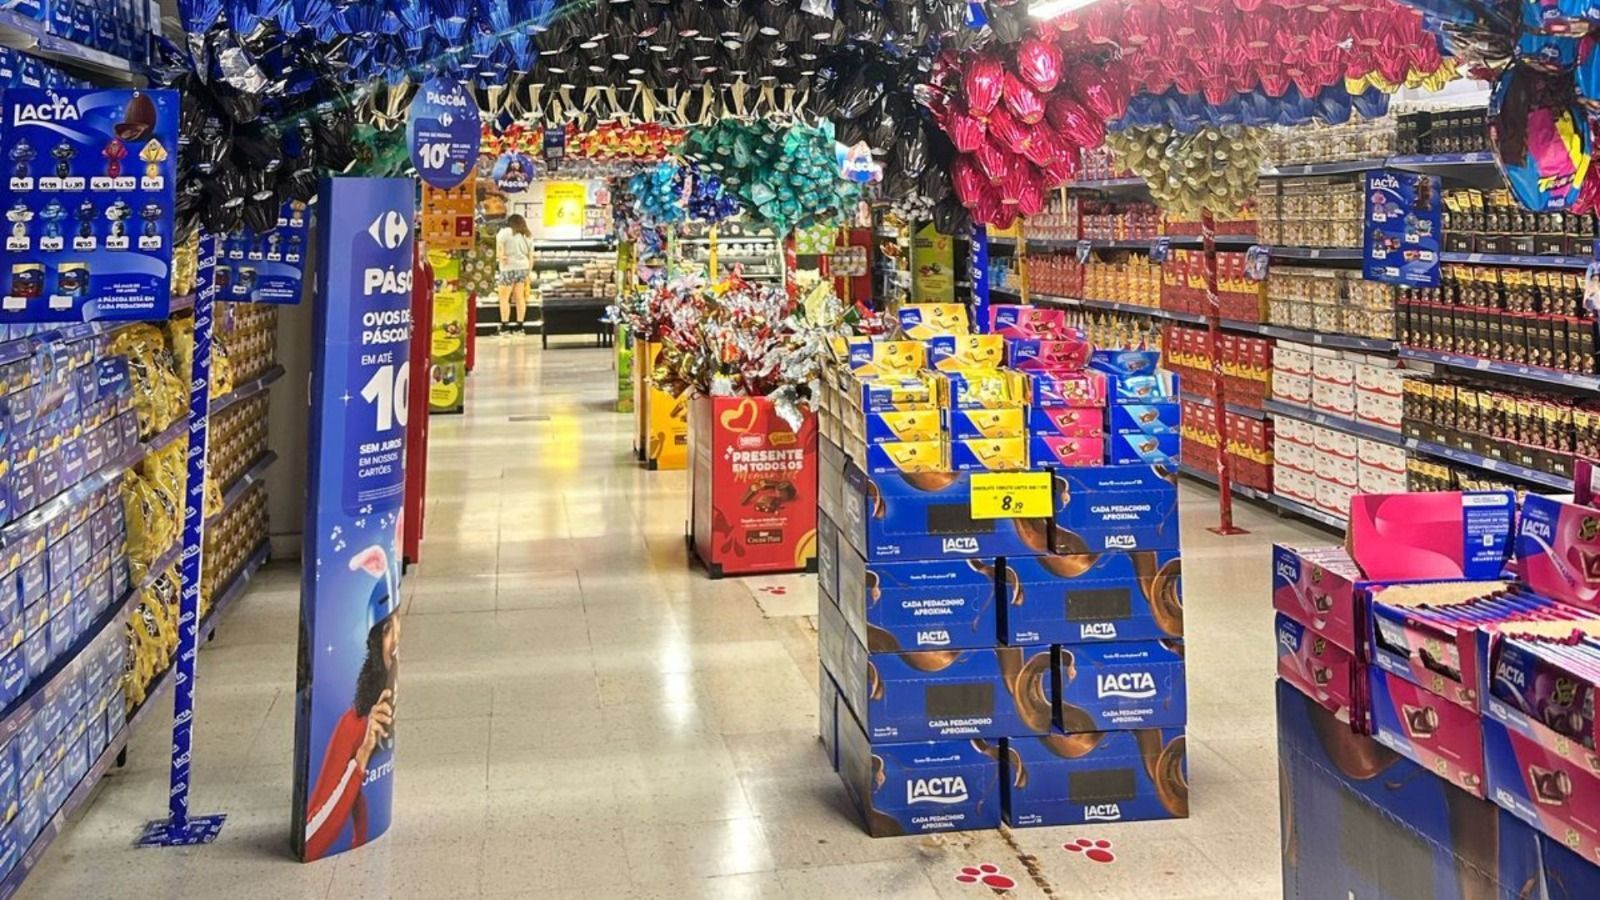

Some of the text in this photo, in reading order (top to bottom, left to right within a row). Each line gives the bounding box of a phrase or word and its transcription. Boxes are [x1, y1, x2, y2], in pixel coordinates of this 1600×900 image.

[14, 98, 79, 126] LACTA
[419, 143, 450, 169] 10X
[1371, 178, 1400, 190] LACTA
[363, 308, 410, 327] OVOS DE
[361, 350, 393, 367] EM ATÉ
[361, 361, 410, 432] 10
[360, 443, 380, 455] SEM
[733, 449, 804, 463] PRESENTE
[359, 452, 399, 467] EM NOSSOS
[733, 461, 804, 473] EM TODOS OS
[359, 464, 392, 478] CARTÕES
[1091, 504, 1151, 513] CADA PEDACINHO
[1102, 512, 1140, 521] APROXIMA.
[1522, 518, 1550, 538] LACTA
[943, 537, 979, 553] LACTA
[1105, 534, 1137, 549] LACTA
[1277, 560, 1297, 580] LACTA
[902, 598, 965, 609] CADA PEDACINHO
[914, 606, 953, 616] APROXIMA.
[917, 630, 950, 645] LACTA
[1081, 624, 1116, 639] LACTA
[1279, 627, 1297, 648] LACTA
[1495, 660, 1525, 688] LACTA
[1098, 672, 1156, 699] LACTA
[1102, 708, 1154, 718] CADA PEDACINHO
[1111, 714, 1144, 723] APROXIMA.
[929, 718, 992, 728] CADA PEDACINHO
[941, 725, 980, 735] APROXIMA.
[907, 776, 968, 805] LACTA
[912, 814, 965, 824] CADA PEDACINHO
[1085, 803, 1120, 820] LACTA
[921, 821, 955, 829] APROXIMA.
